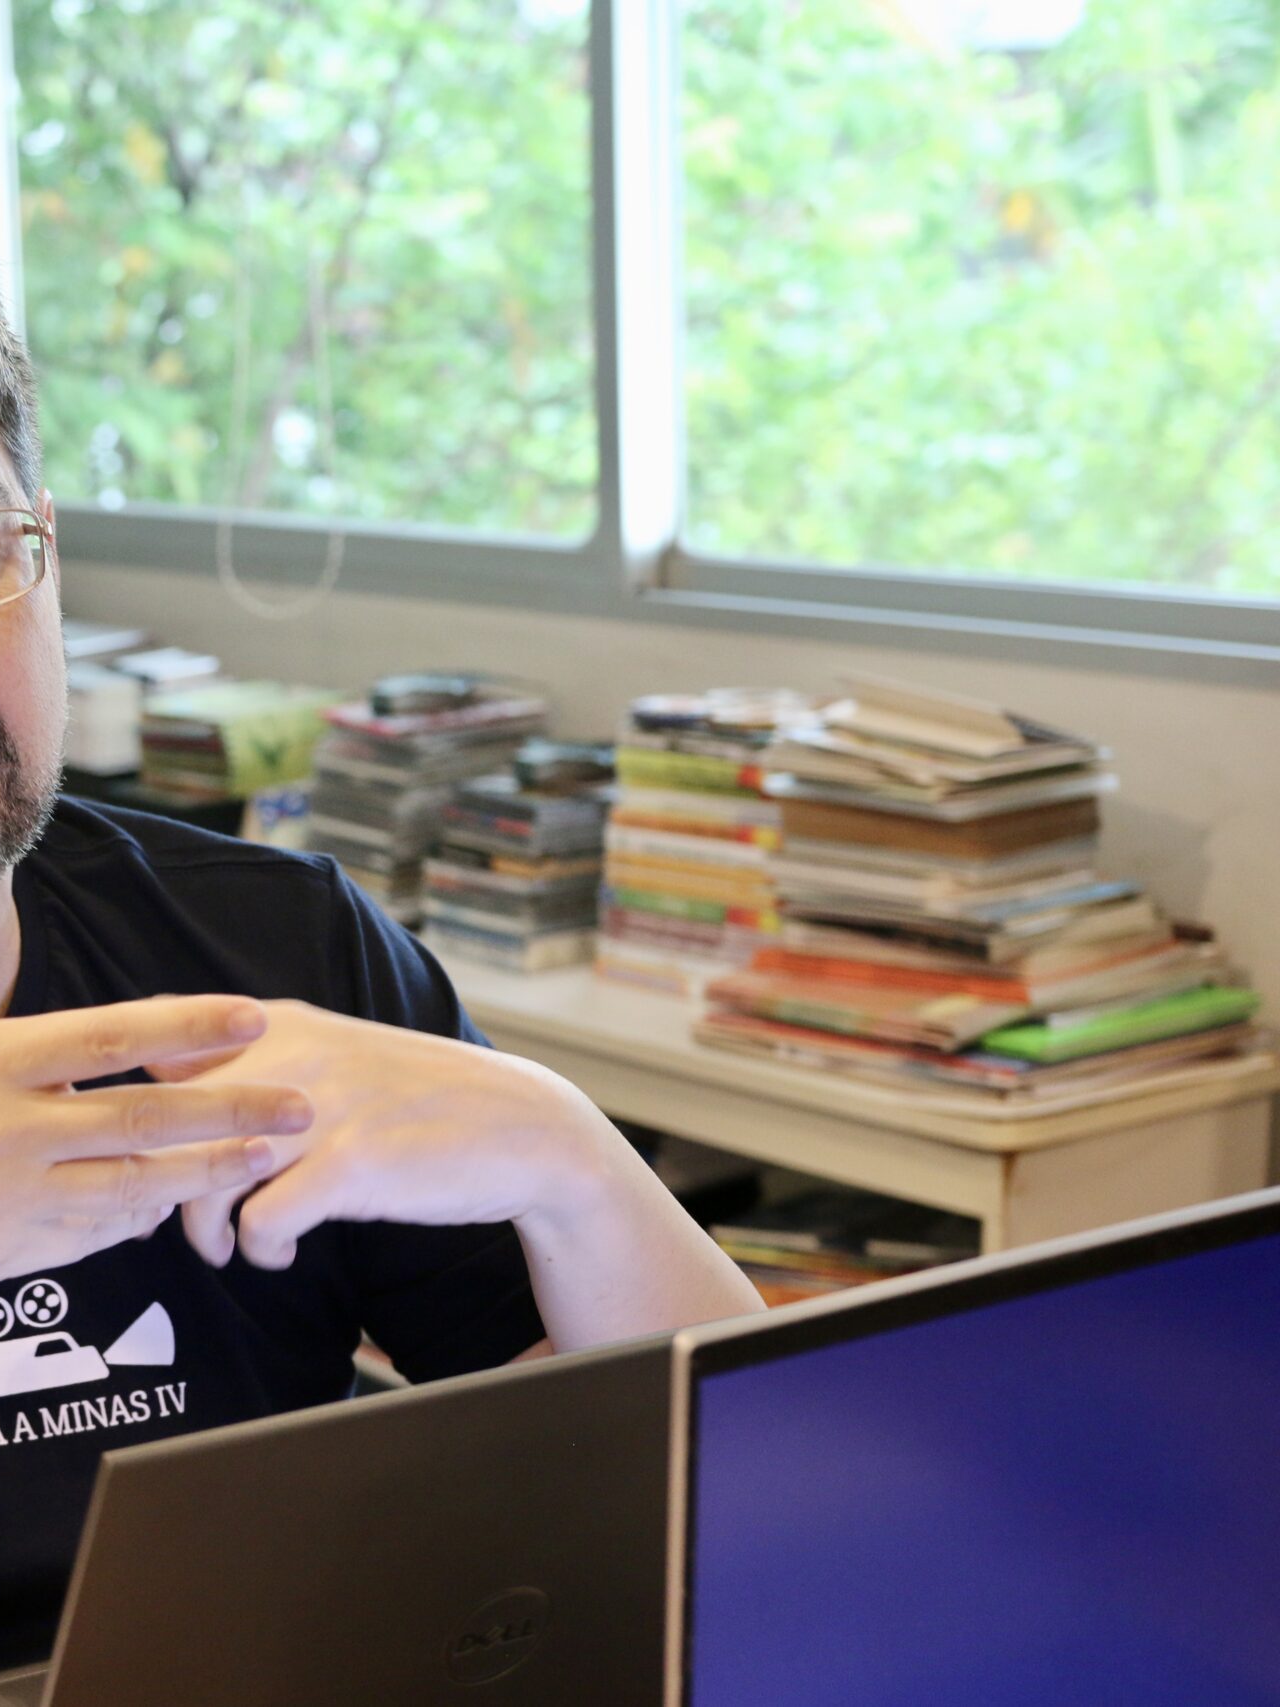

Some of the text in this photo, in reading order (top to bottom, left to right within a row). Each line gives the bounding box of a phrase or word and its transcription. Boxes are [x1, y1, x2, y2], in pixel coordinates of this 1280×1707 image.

[13, 1411, 39, 1444] A
[39, 1389, 151, 1439] MINAS
[155, 1381, 187, 1418] IV
